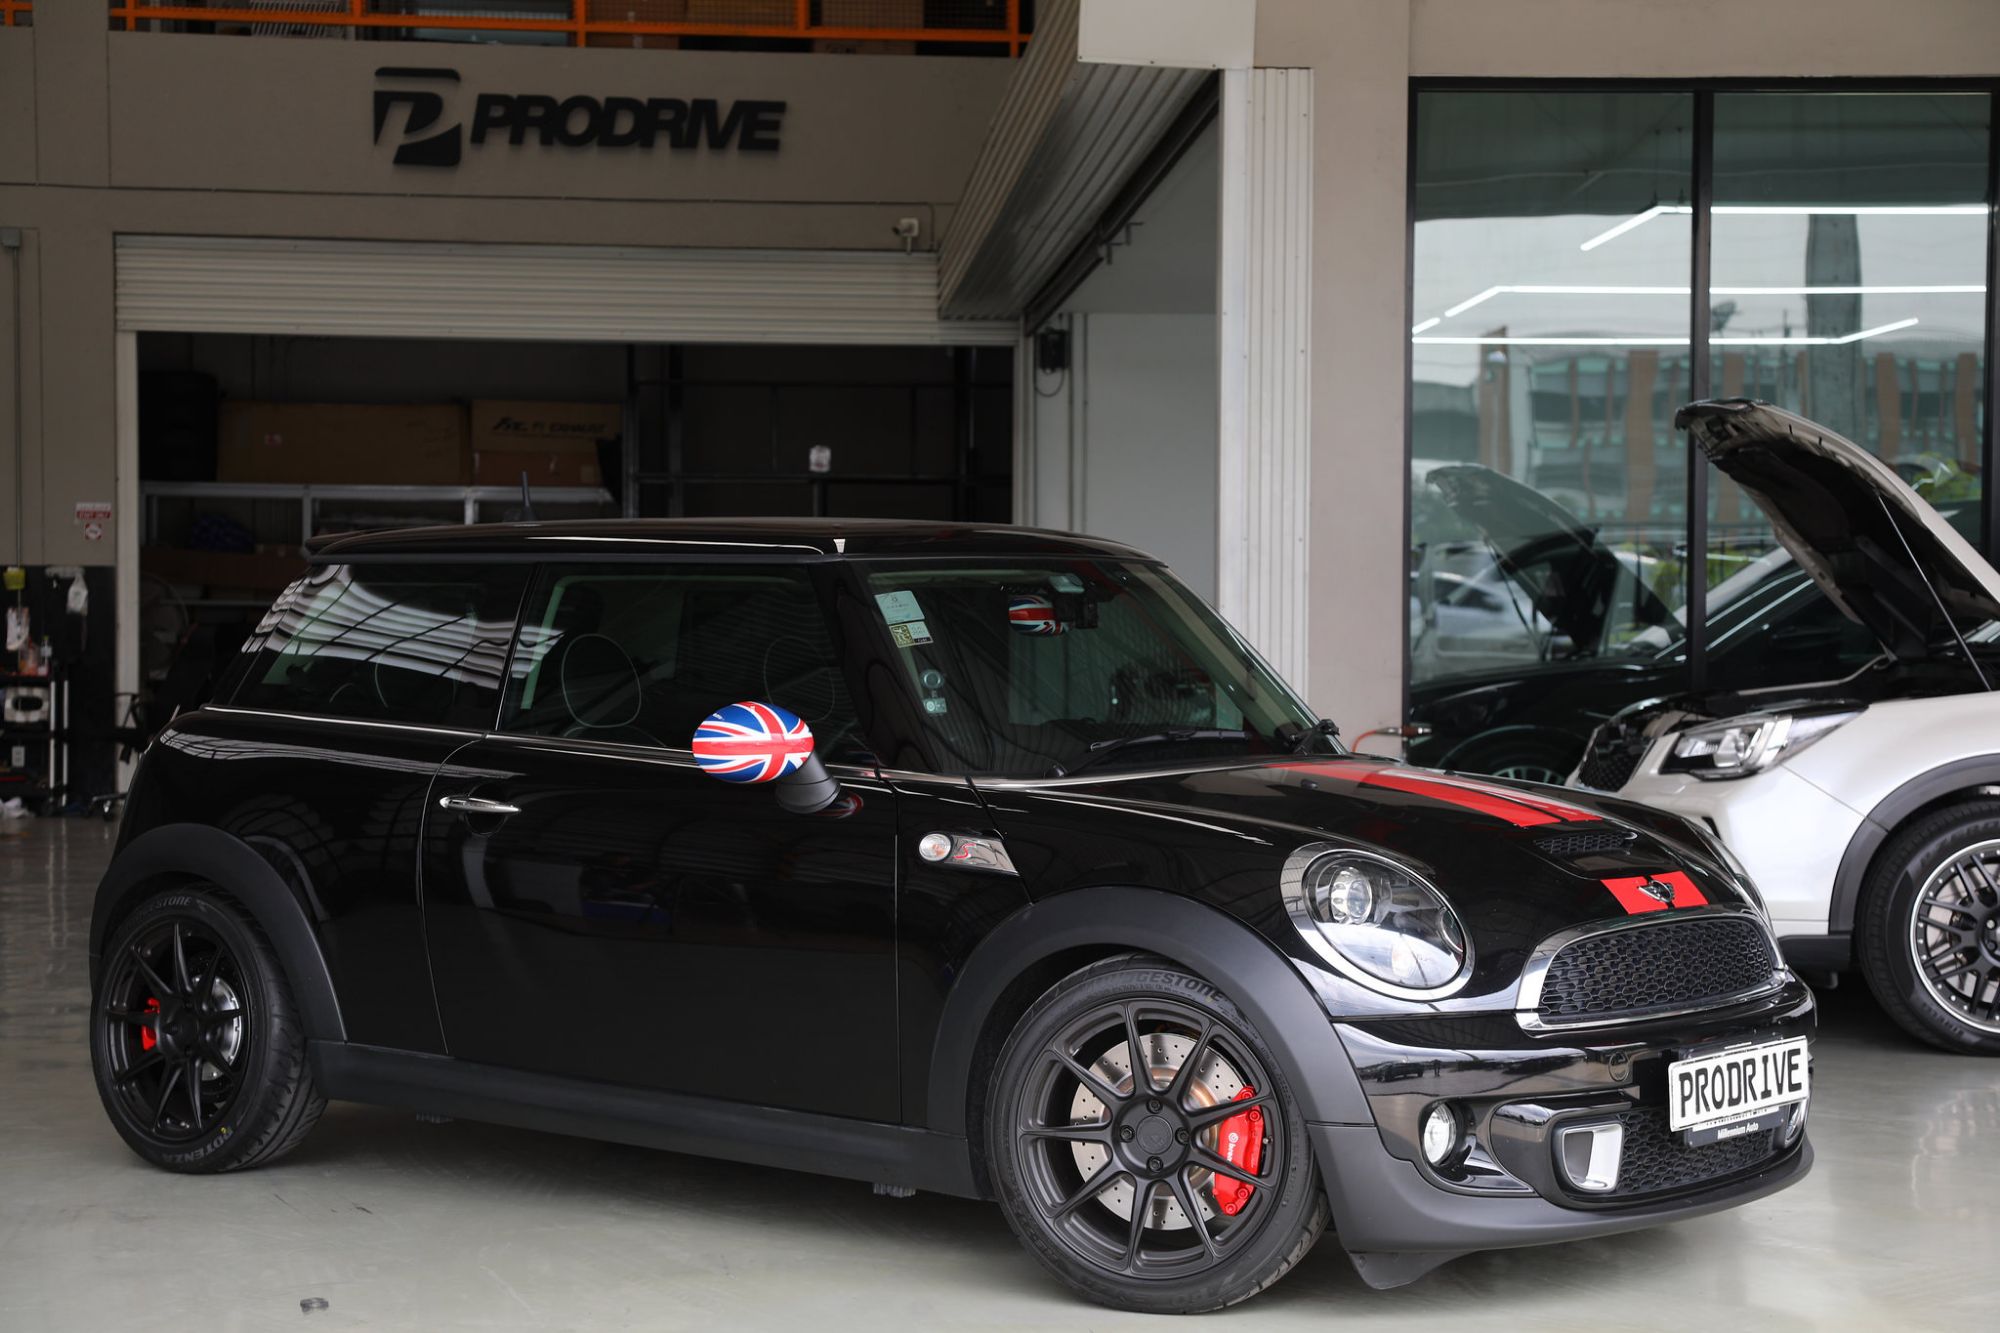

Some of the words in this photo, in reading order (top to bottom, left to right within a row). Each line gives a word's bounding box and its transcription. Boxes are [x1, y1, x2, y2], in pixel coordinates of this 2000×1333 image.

[470, 93, 787, 151] PRODRIVE
[953, 843, 977, 859] S
[1678, 1048, 1803, 1118] PRODRIVE
[1746, 1121, 1759, 1134] Auto
